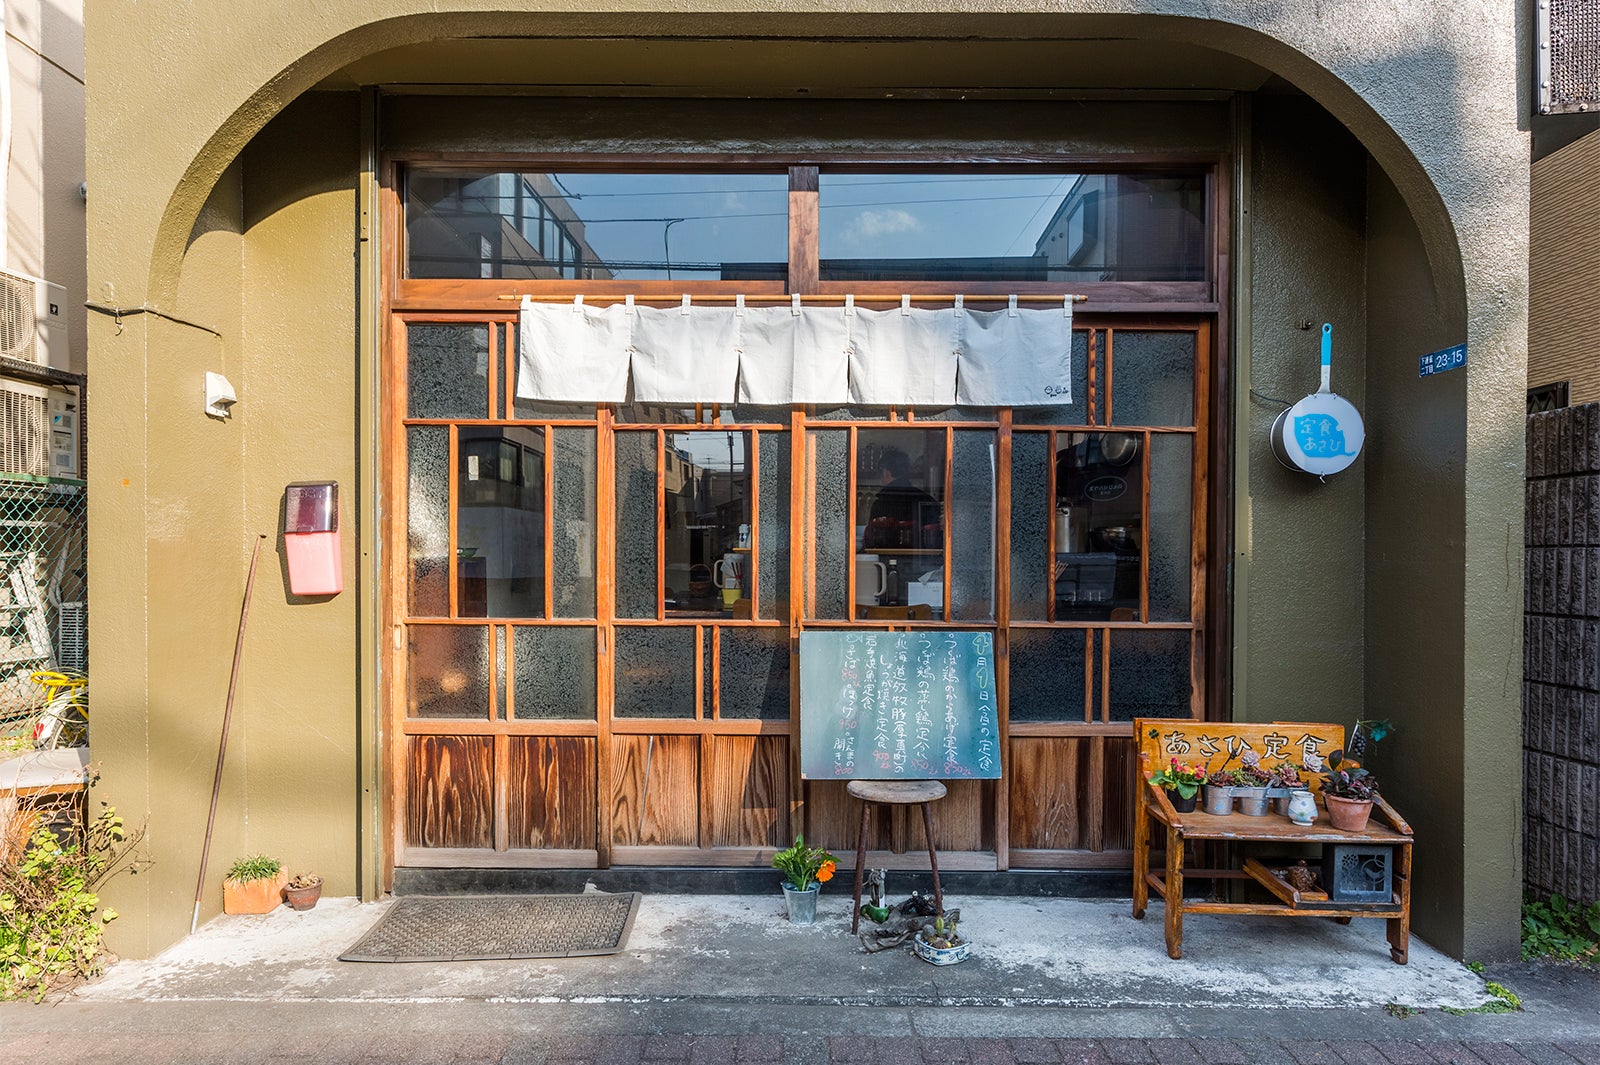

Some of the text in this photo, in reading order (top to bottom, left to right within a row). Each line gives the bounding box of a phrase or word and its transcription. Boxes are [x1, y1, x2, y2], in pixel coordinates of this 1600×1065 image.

[1435, 349, 1463, 368] 23-15
[1300, 418, 1333, 436] 定食
[1304, 437, 1342, 453] あさひ
